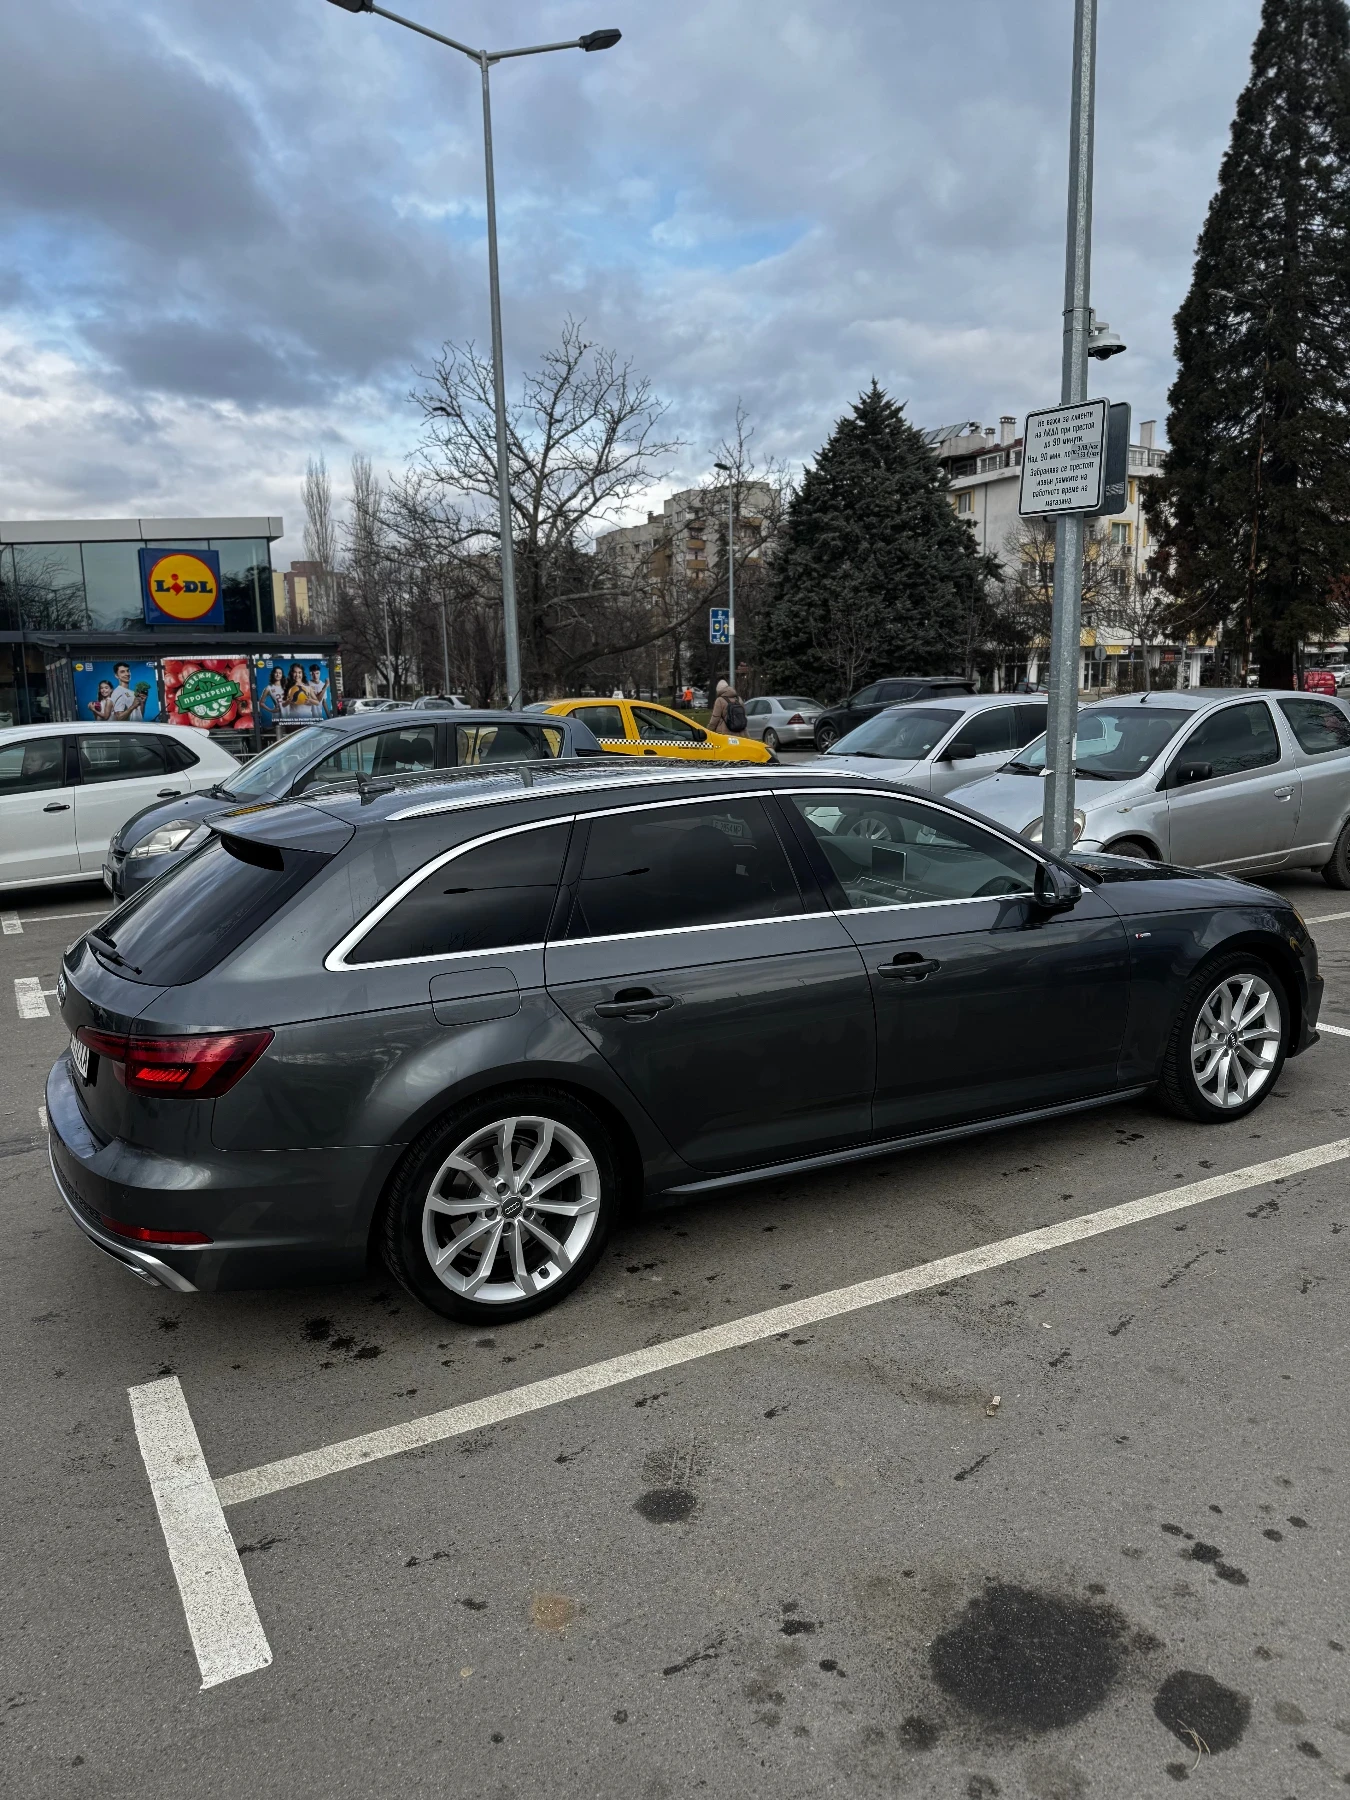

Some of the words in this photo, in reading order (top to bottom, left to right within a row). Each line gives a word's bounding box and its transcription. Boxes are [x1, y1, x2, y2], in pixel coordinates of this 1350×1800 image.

[1047, 418, 1061, 426] важи
[1035, 431, 1042, 439] на
[1061, 426, 1071, 436] при
[1053, 438, 1061, 447] 90
[1062, 436, 1084, 445] минути
[1028, 454, 1039, 463] Над
[1041, 453, 1048, 462] 90
[1030, 467, 1059, 477] Забранява
[1061, 465, 1068, 473] се
[1081, 473, 1088, 481] на
[1061, 485, 1080, 495] време
[1045, 498, 1072, 507] магазина
[186, 672, 212, 689] СВЕЖИ
[214, 674, 221, 682] И
[183, 685, 232, 704] ПРОВЕРЕНИ
